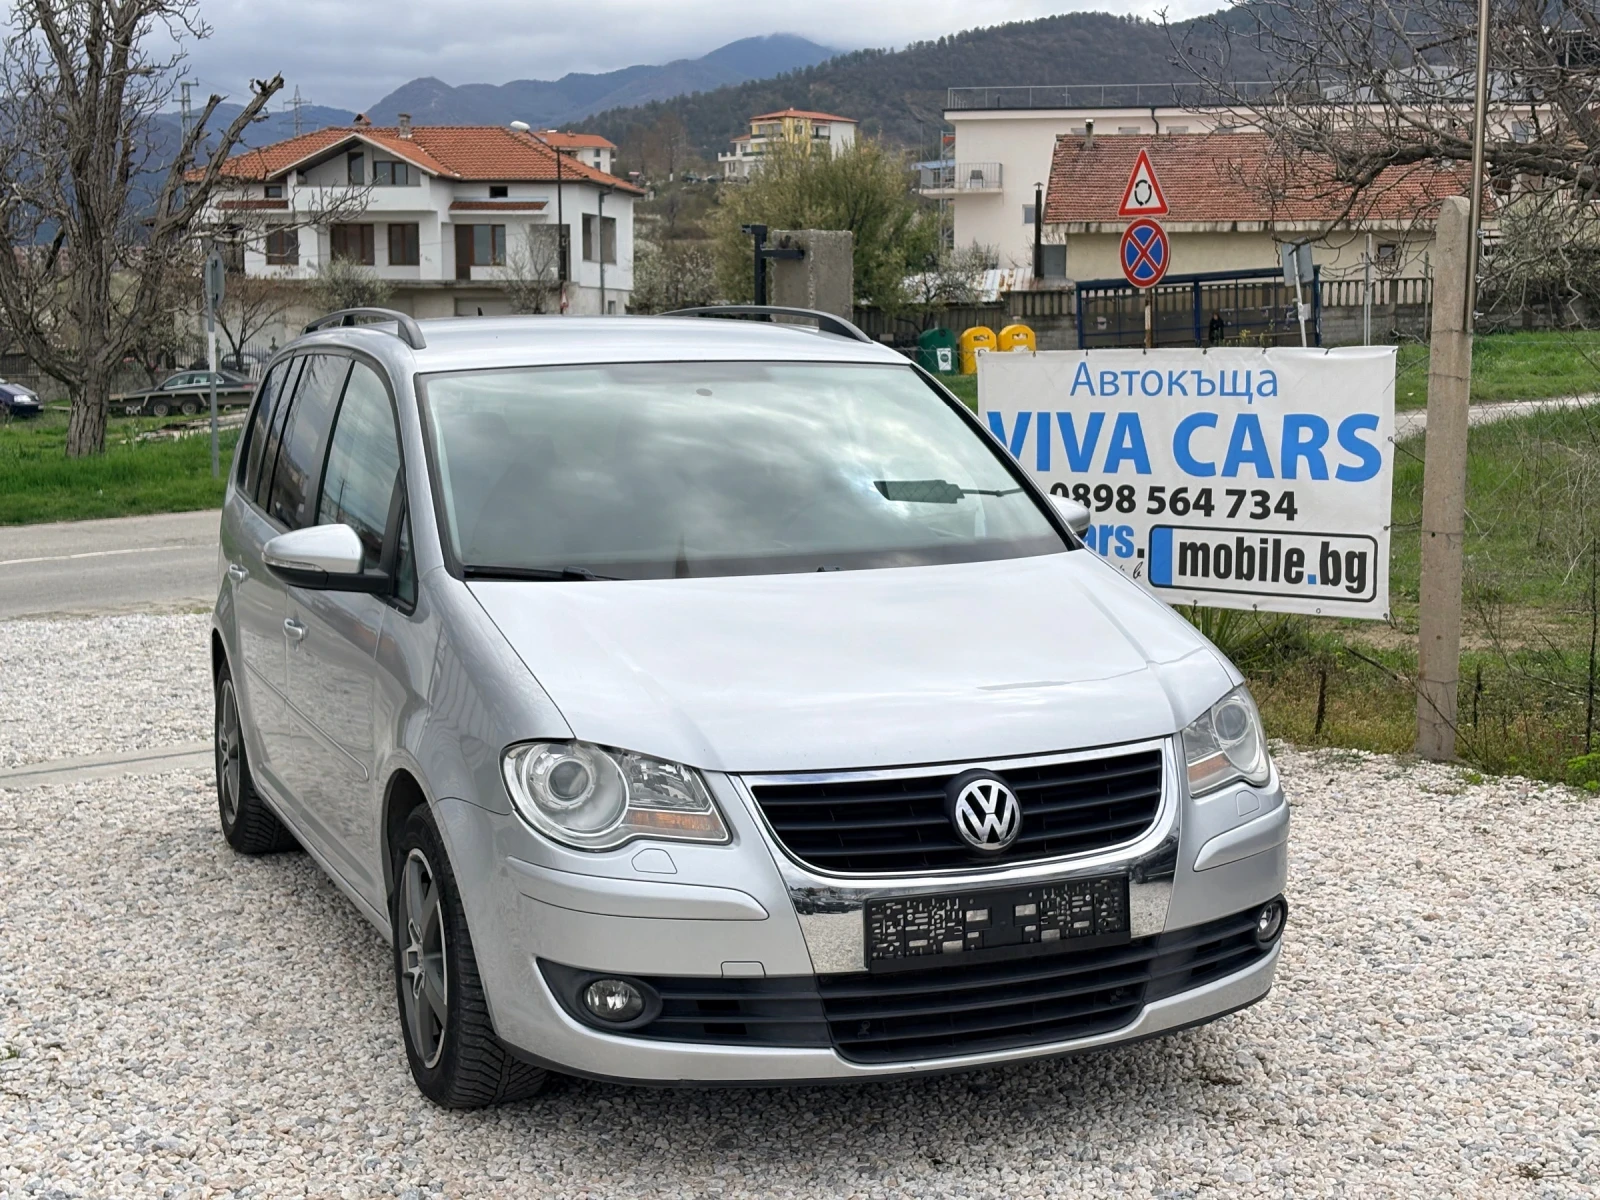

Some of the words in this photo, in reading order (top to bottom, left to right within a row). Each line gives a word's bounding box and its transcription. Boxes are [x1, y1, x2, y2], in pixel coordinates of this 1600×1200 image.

[1070, 361, 1278, 404] Автокъща
[987, 411, 1152, 475] VIVA
[1172, 411, 1382, 482] CARS
[1146, 485, 1215, 517] 564
[1225, 488, 1298, 521] 734
[1178, 536, 1368, 594] mobile.bg
